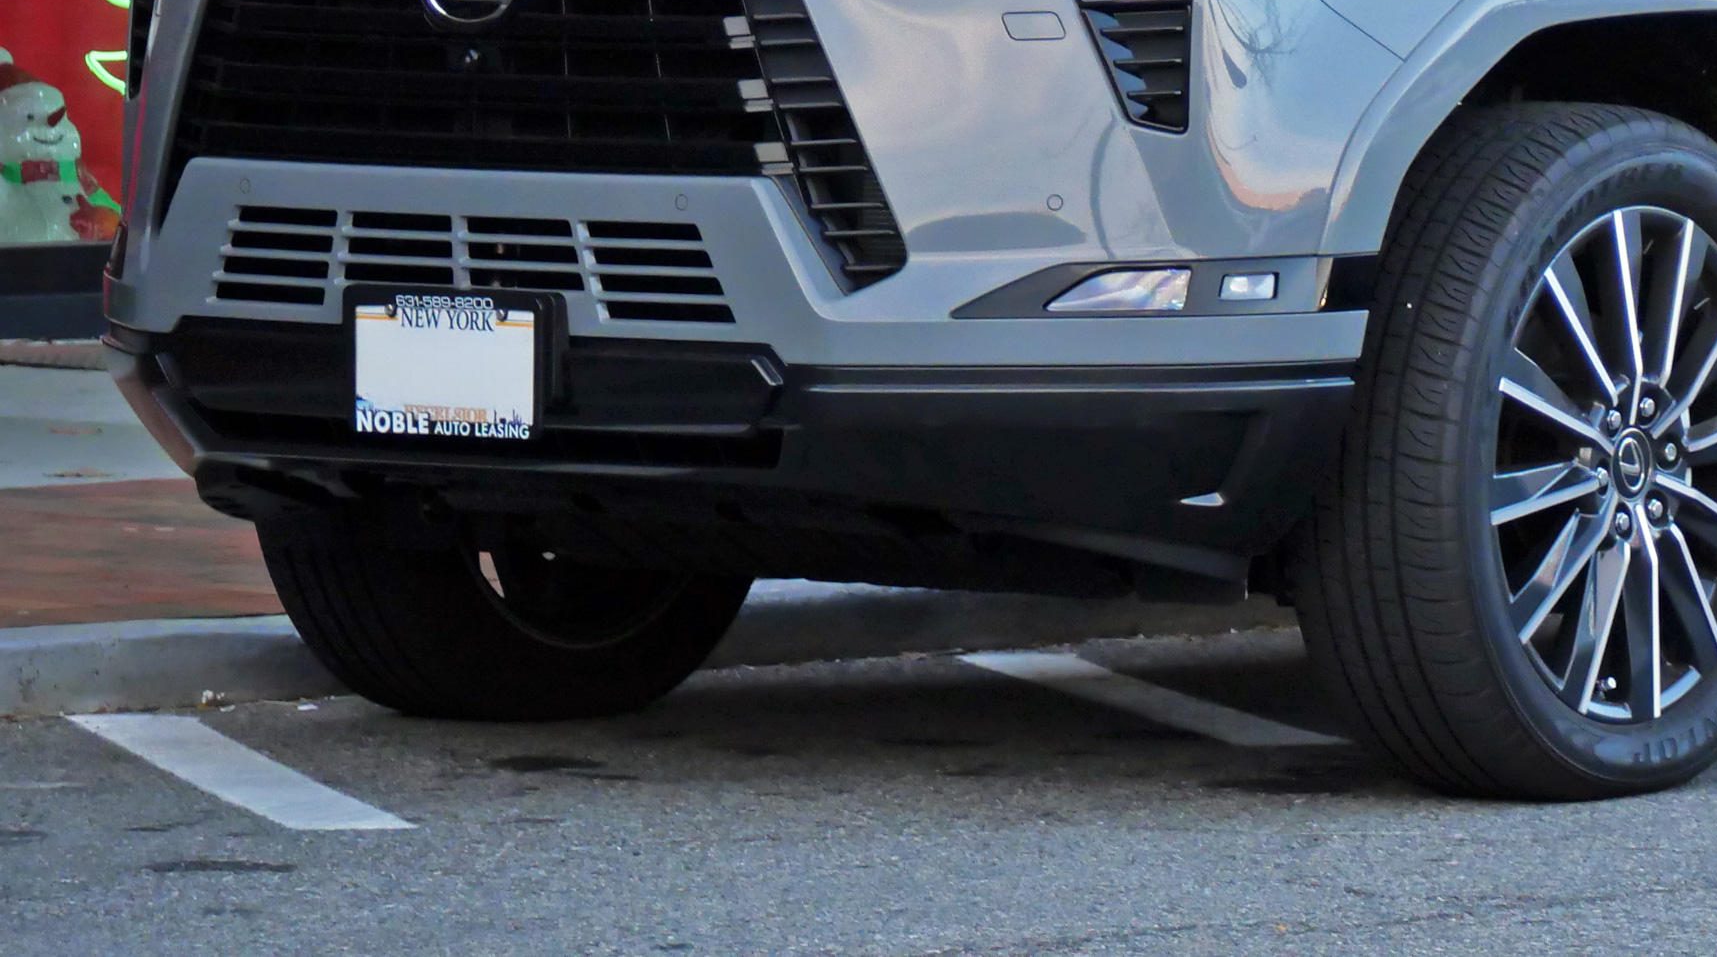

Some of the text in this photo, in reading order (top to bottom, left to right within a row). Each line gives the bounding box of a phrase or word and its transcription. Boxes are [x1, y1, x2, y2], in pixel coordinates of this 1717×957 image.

[400, 308, 495, 333] NEW YORK
[355, 410, 531, 441] NOBLE AUTO LEASING
